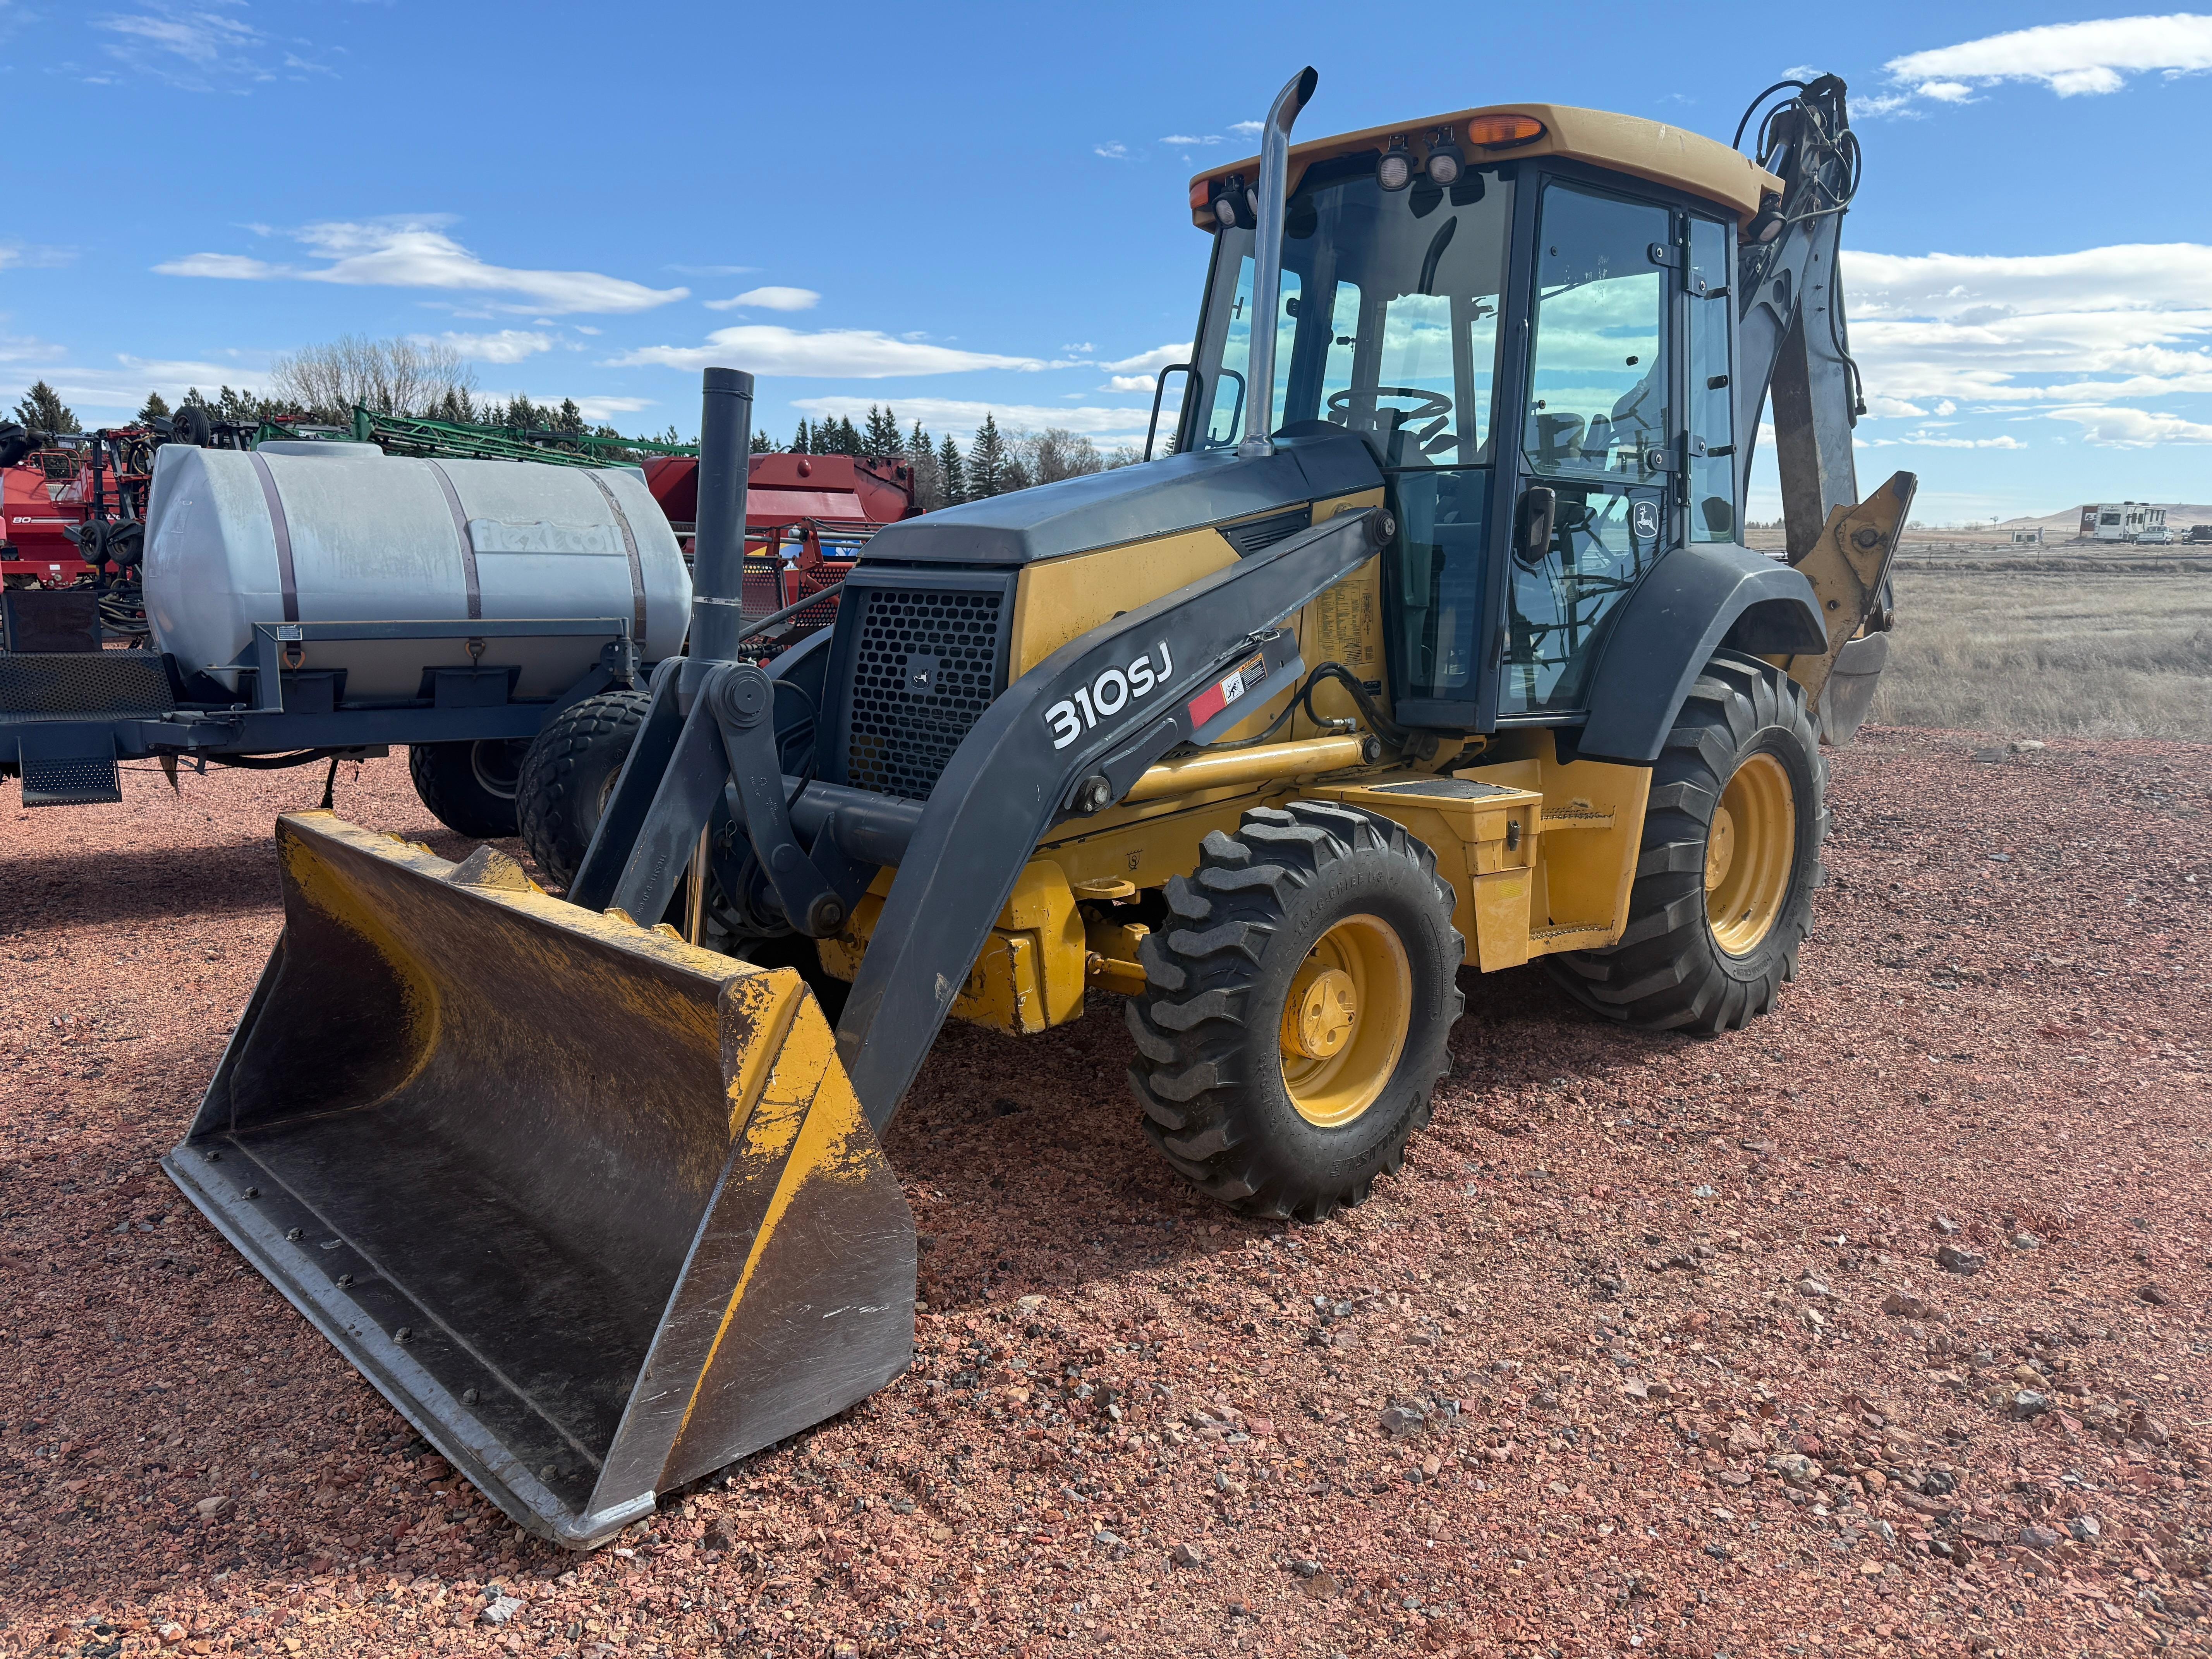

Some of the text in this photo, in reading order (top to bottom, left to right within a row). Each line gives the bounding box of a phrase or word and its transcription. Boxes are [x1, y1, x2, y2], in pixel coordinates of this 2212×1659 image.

[1045, 642, 1172, 750] 310SJ
[1244, 654, 1260, 668] WARNING
[1330, 1090, 1421, 1177] CARLISLE
